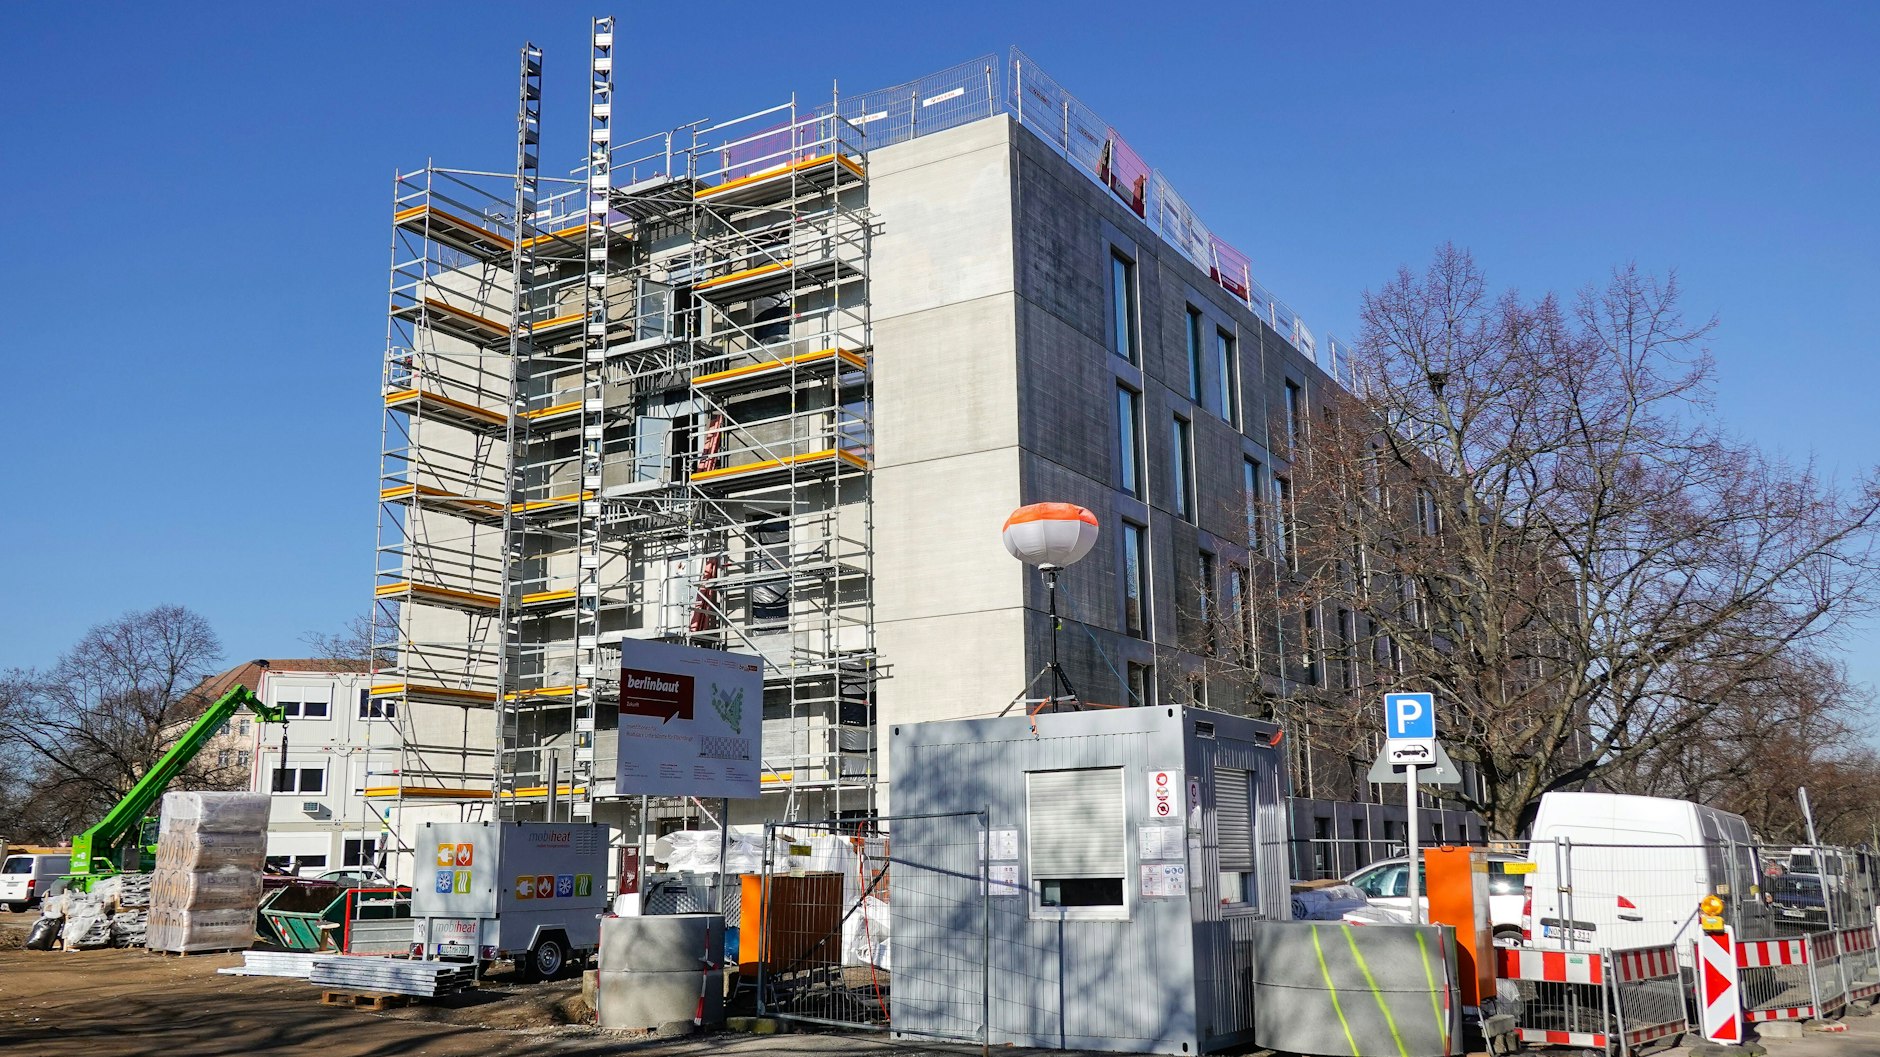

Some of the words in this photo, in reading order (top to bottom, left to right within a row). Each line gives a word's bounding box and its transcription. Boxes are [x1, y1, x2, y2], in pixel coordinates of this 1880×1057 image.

[627, 674, 680, 693] berlinbaut
[1396, 698, 1423, 734] P
[528, 830, 571, 842] mobiheat
[435, 920, 476, 933] mobiheat
